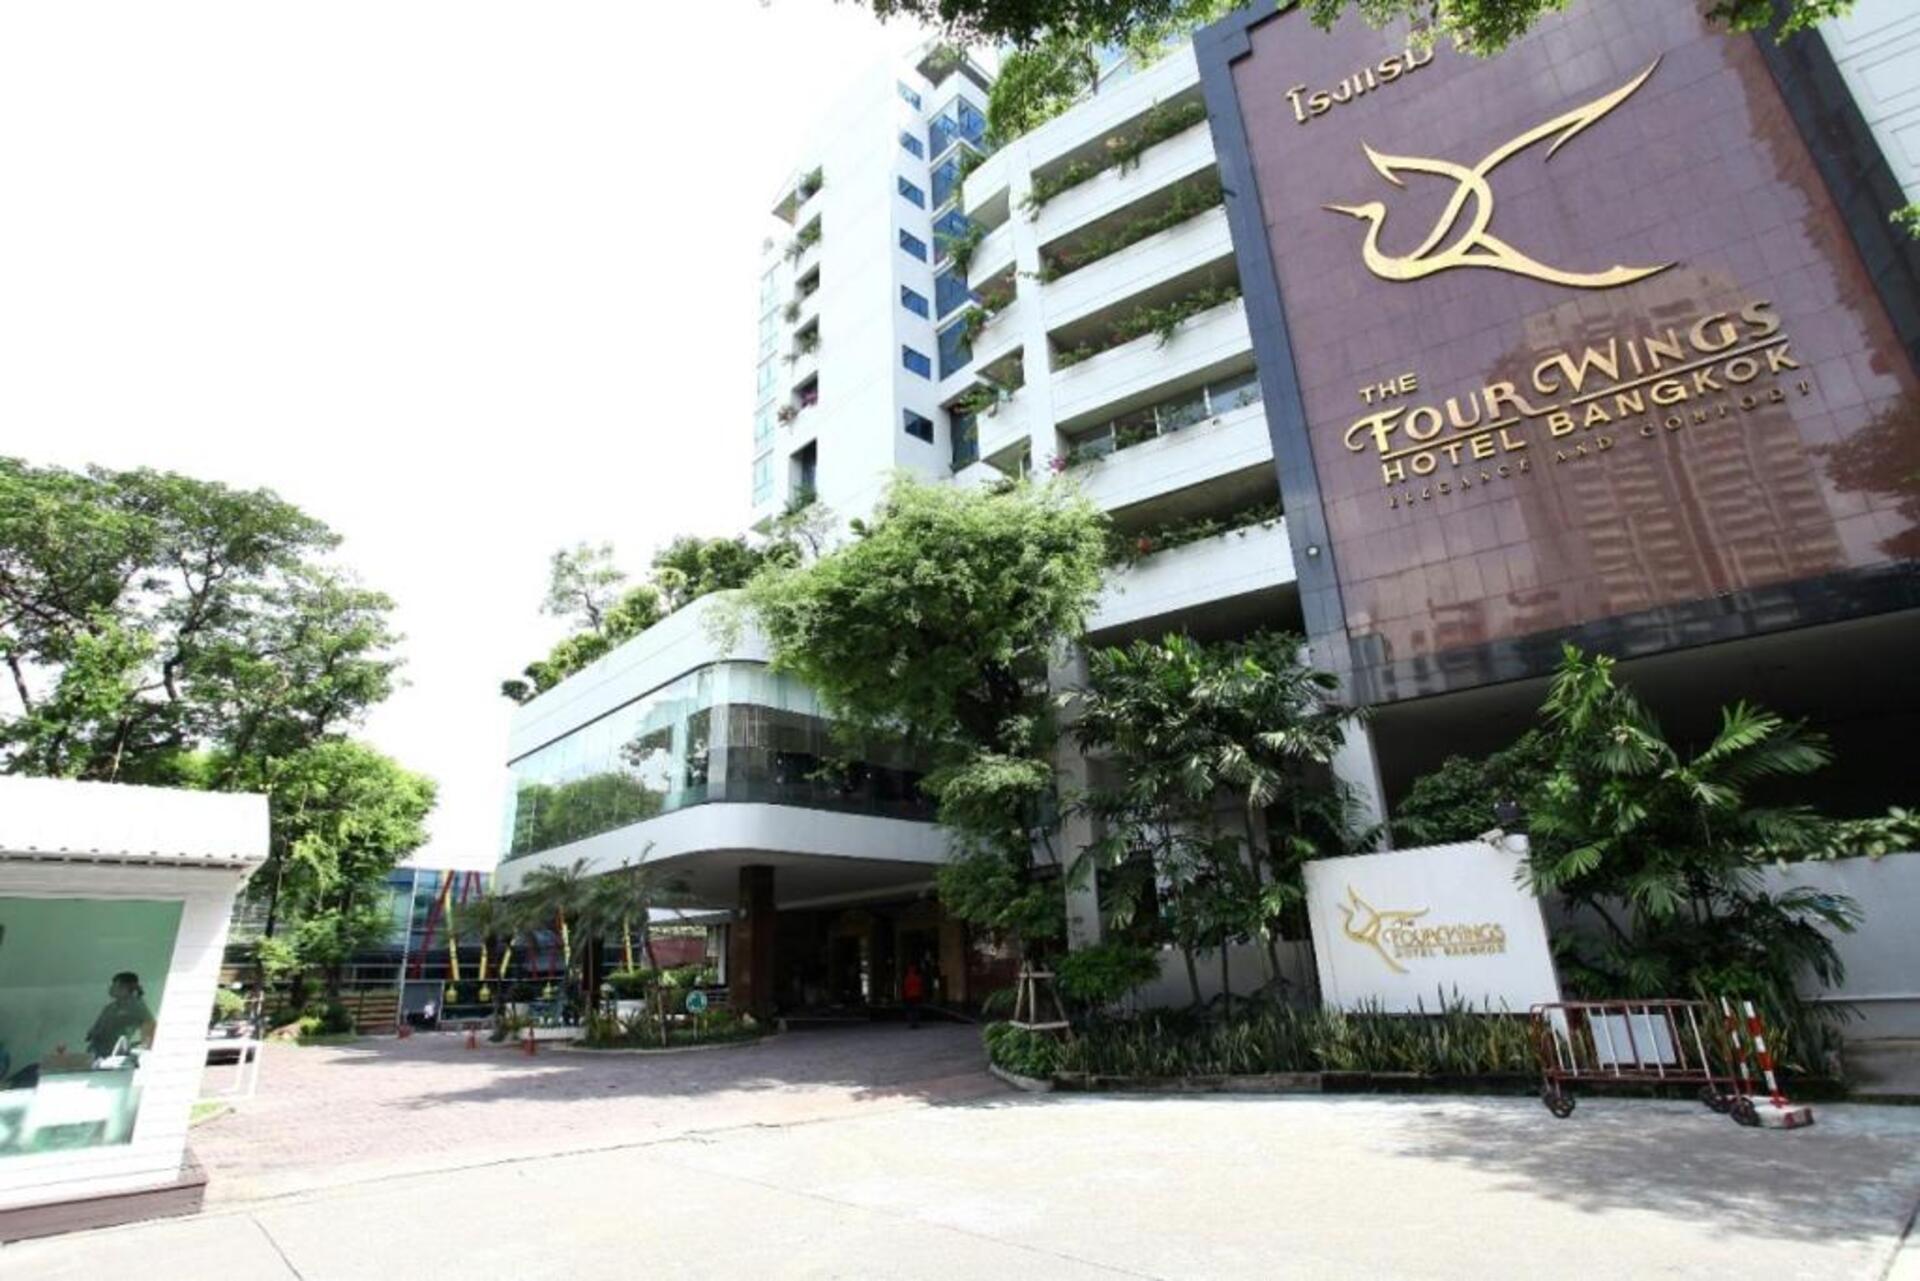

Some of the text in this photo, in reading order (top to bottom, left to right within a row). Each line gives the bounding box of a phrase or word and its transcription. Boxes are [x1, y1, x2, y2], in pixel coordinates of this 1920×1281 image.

[1344, 299, 1781, 454] FOUR WINGS
[1359, 372, 1418, 405] THE
[1381, 344, 1800, 486] HOTEL BANGKOK
[1555, 436, 1614, 463] AND
